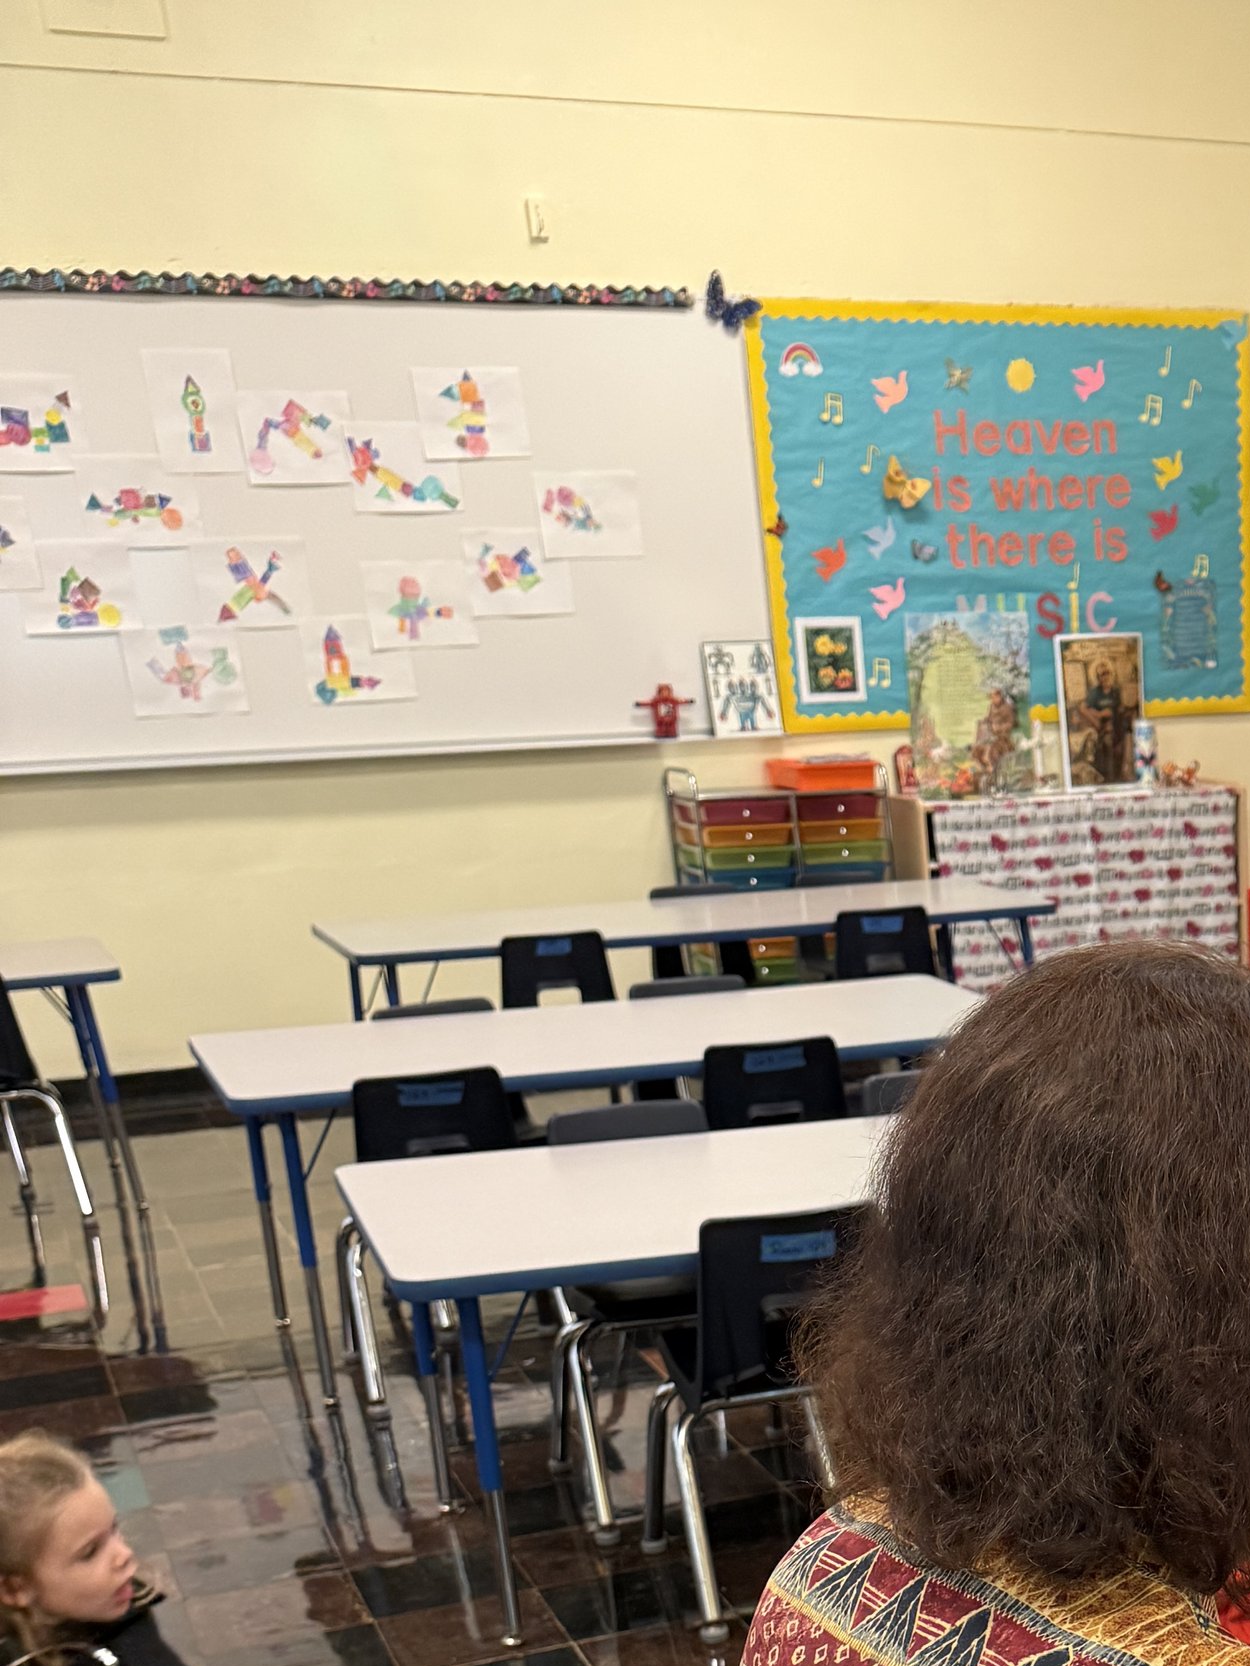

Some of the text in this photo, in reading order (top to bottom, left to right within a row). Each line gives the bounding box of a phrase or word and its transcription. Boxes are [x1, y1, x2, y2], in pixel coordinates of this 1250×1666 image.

[933, 408, 1118, 457] Heaven
[932, 466, 1132, 513] is where
[946, 517, 1128, 569] there is
